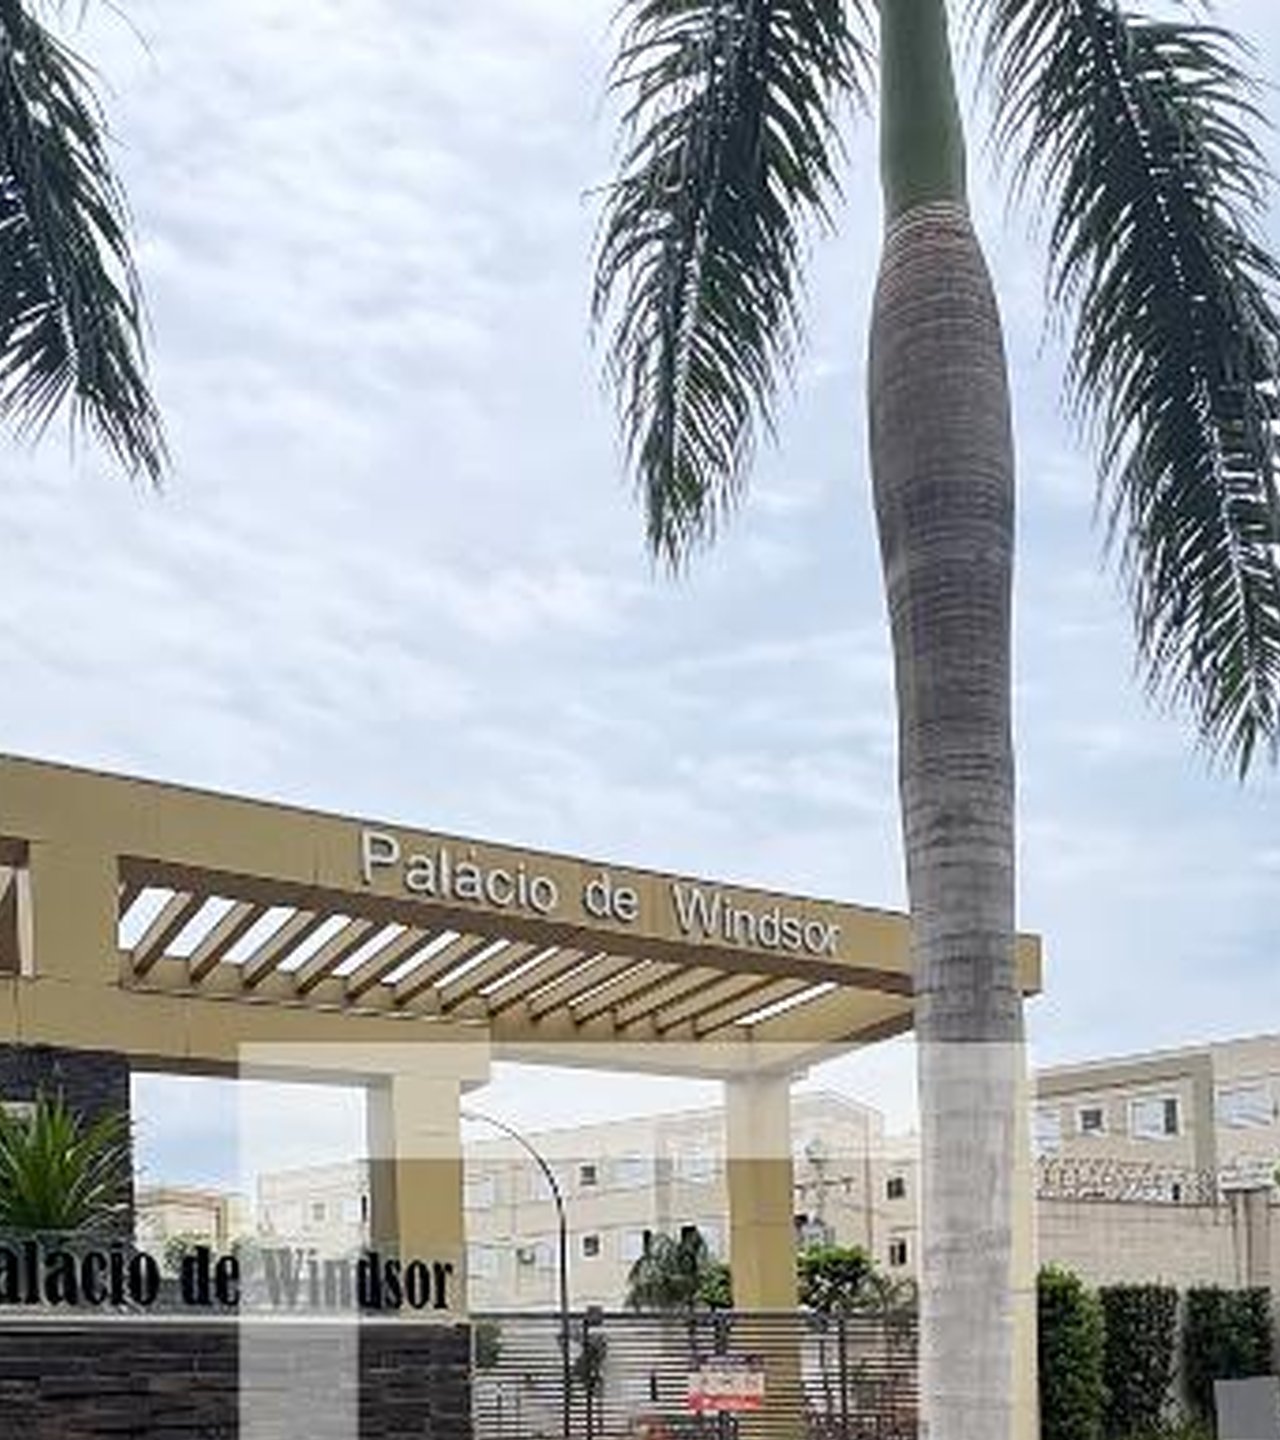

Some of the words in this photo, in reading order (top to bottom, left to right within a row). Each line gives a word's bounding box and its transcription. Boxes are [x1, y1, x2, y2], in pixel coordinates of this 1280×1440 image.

[585, 873, 639, 921] de
[673, 884, 842, 955] Windsor
[180, 1244, 240, 1305] de
[261, 1244, 452, 1309] Windsor
